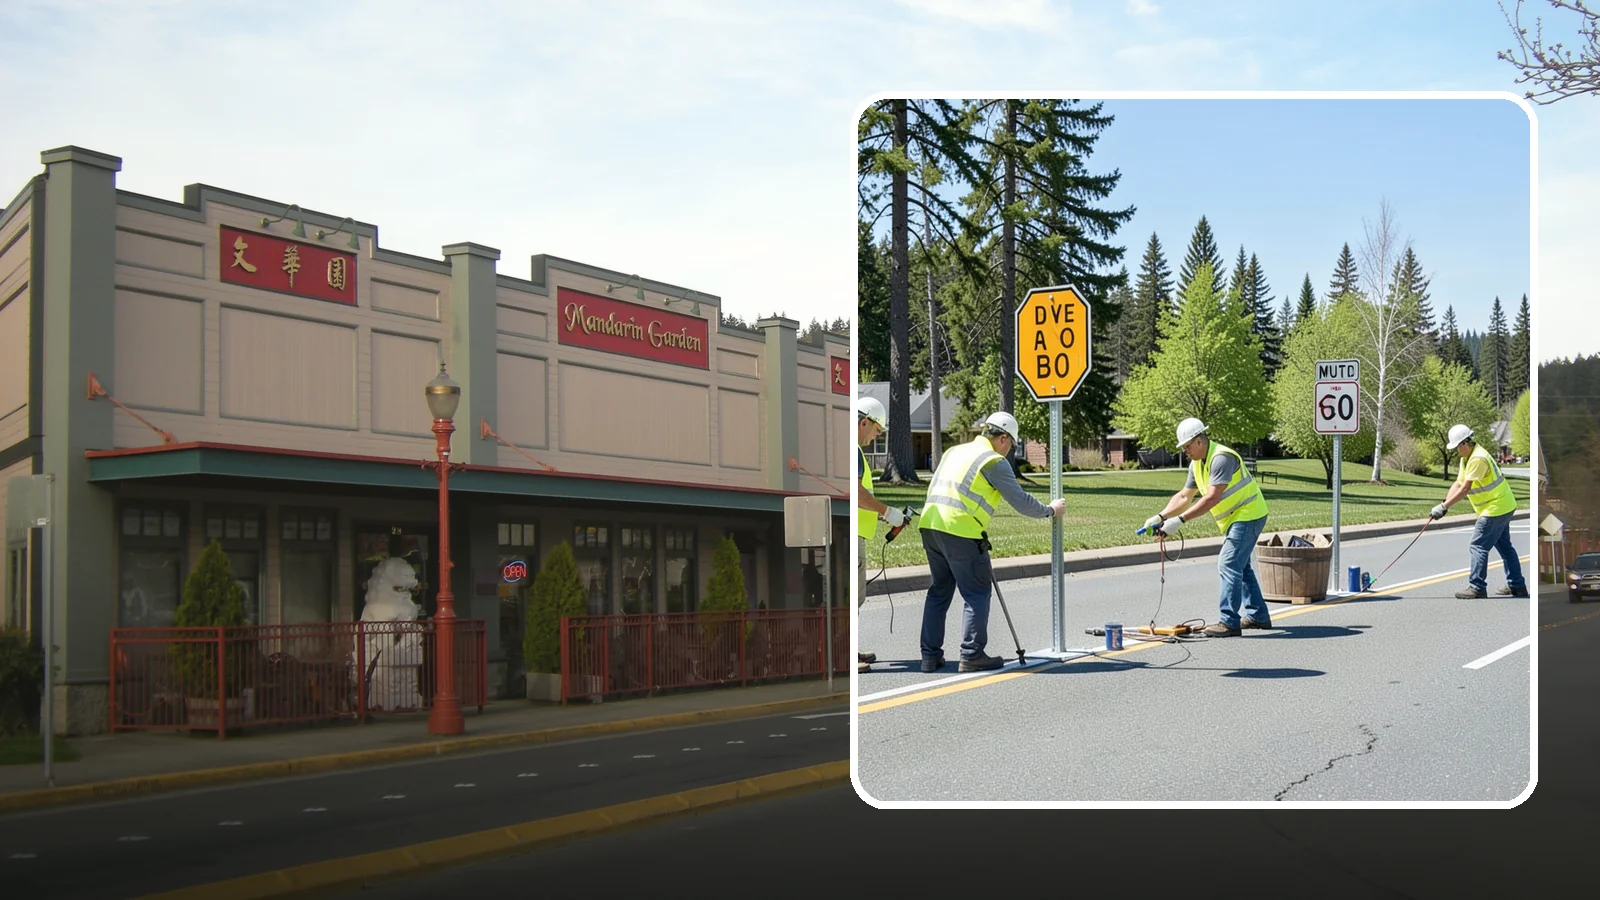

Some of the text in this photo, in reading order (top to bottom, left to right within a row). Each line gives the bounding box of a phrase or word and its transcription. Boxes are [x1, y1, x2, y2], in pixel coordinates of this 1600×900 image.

[231, 236, 346, 291] 文華園
[564, 302, 702, 352] Mandarin Garden
[1037, 353, 1070, 379] BO
[1318, 394, 1354, 421] 60
[503, 565, 527, 578] OPEN
